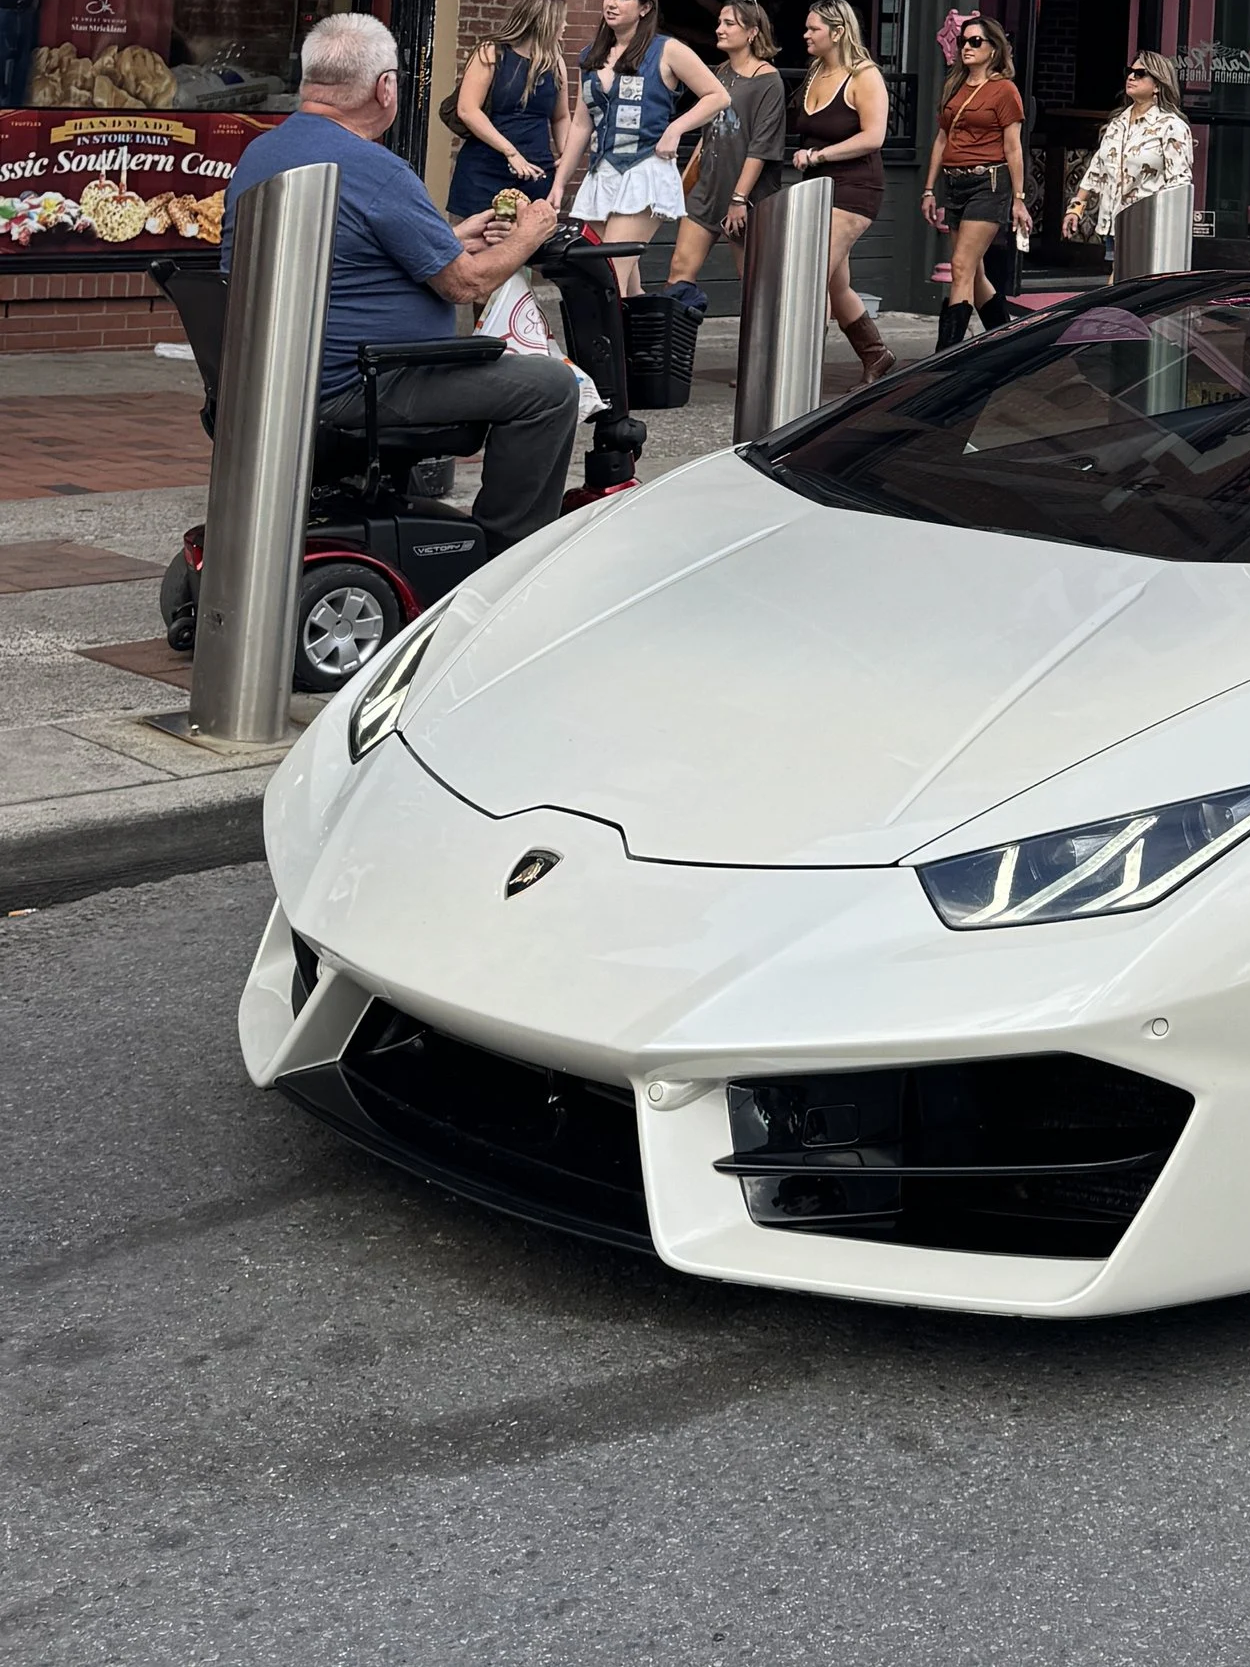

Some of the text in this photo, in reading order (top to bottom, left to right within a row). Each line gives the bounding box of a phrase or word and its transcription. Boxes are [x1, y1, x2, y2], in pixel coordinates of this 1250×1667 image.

[73, 117, 175, 132] HANDMADE
[77, 134, 170, 146] IN STORE DAILY
[53, 145, 174, 174] Southern
